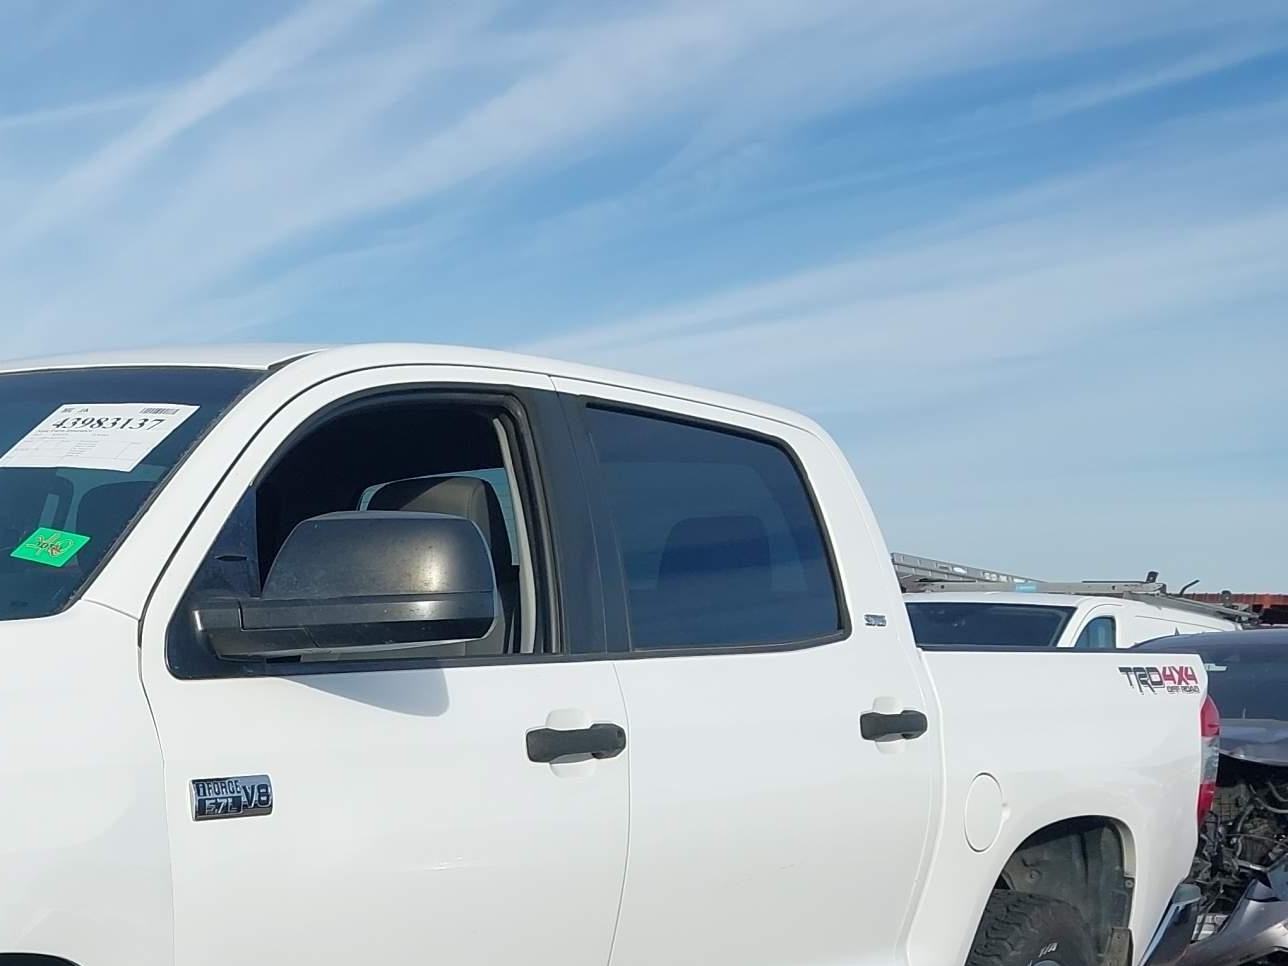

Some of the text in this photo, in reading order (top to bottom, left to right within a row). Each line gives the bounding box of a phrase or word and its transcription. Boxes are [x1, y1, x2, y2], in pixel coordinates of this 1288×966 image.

[51, 416, 166, 431] 43983137
[1118, 667, 1165, 695] TRD
[242, 783, 271, 808] V8
